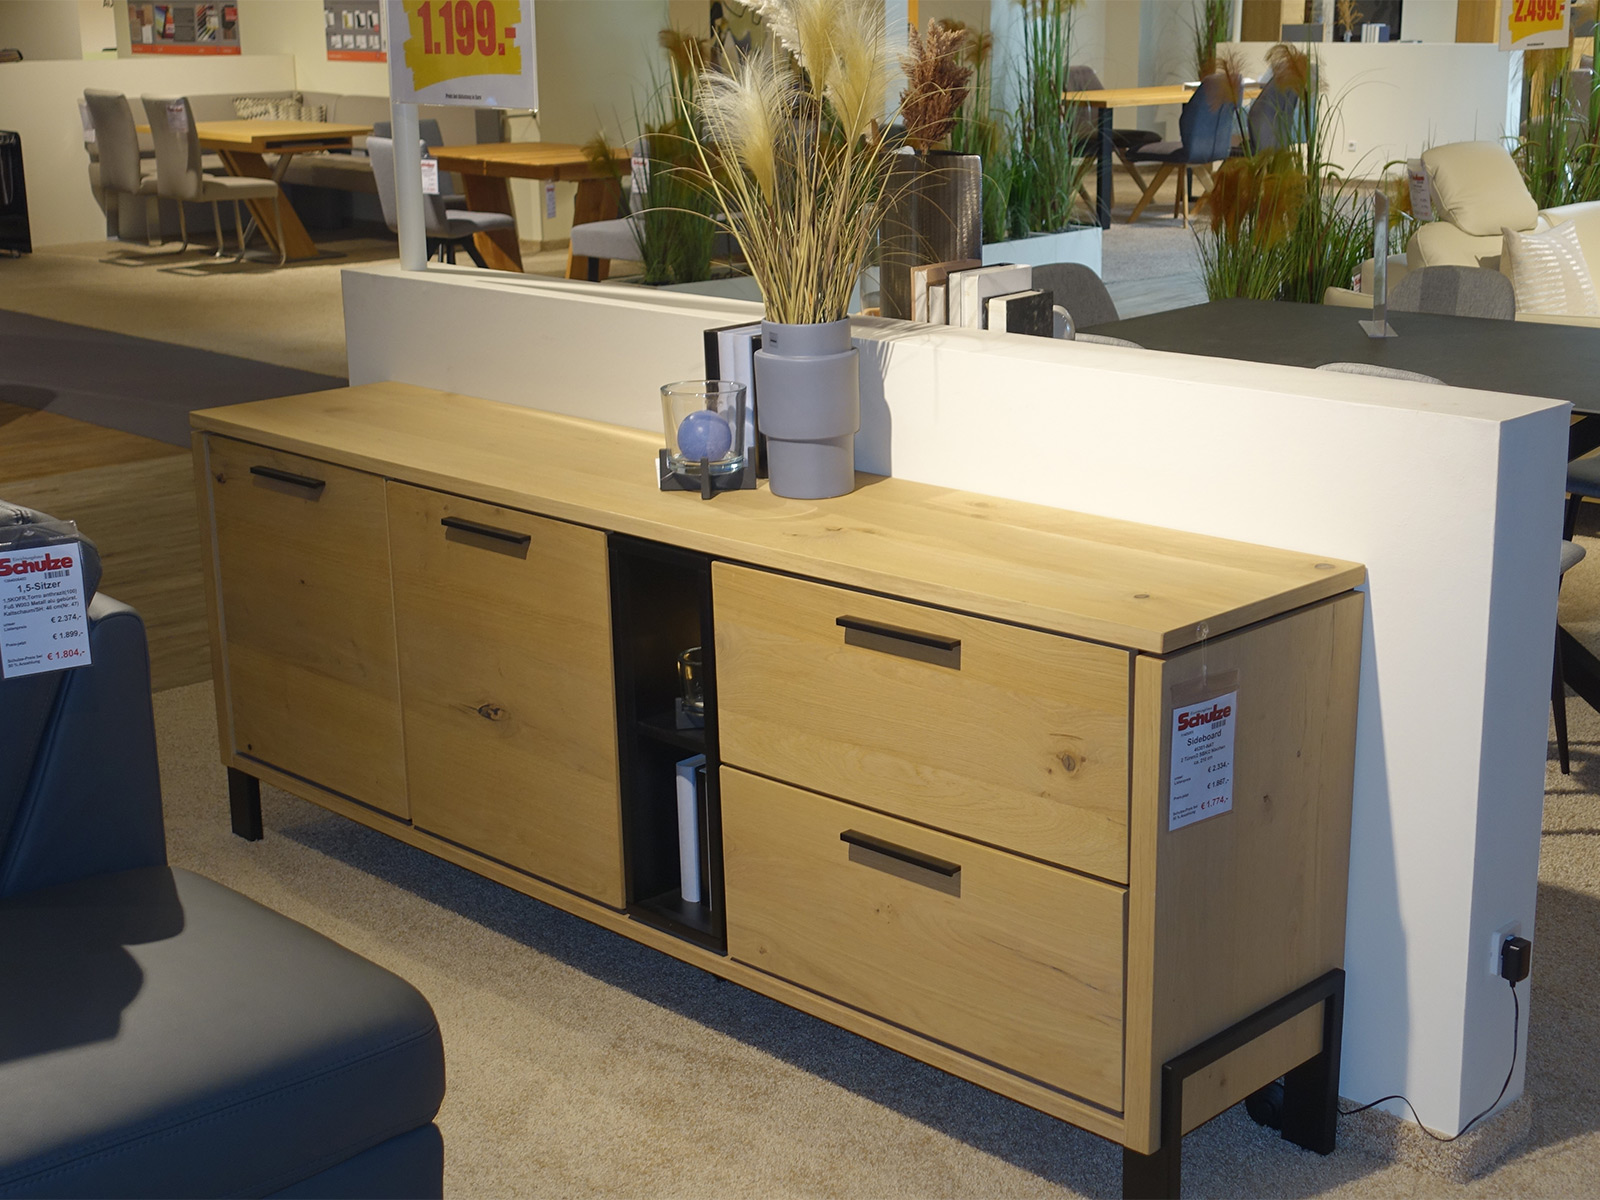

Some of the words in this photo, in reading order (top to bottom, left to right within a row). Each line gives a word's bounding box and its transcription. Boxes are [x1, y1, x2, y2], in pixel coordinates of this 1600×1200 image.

[0, 553, 73, 576] Schulze
[17, 581, 61, 594] 1,5-Sitzer
[57, 613, 82, 623] 2.374,-
[59, 630, 83, 639] 1.899,-
[55, 648, 85, 659] 1.804,-
[1178, 704, 1231, 731] Schulze
[1187, 729, 1222, 746] Sideboard
[1206, 796, 1229, 808] 1.774,-
